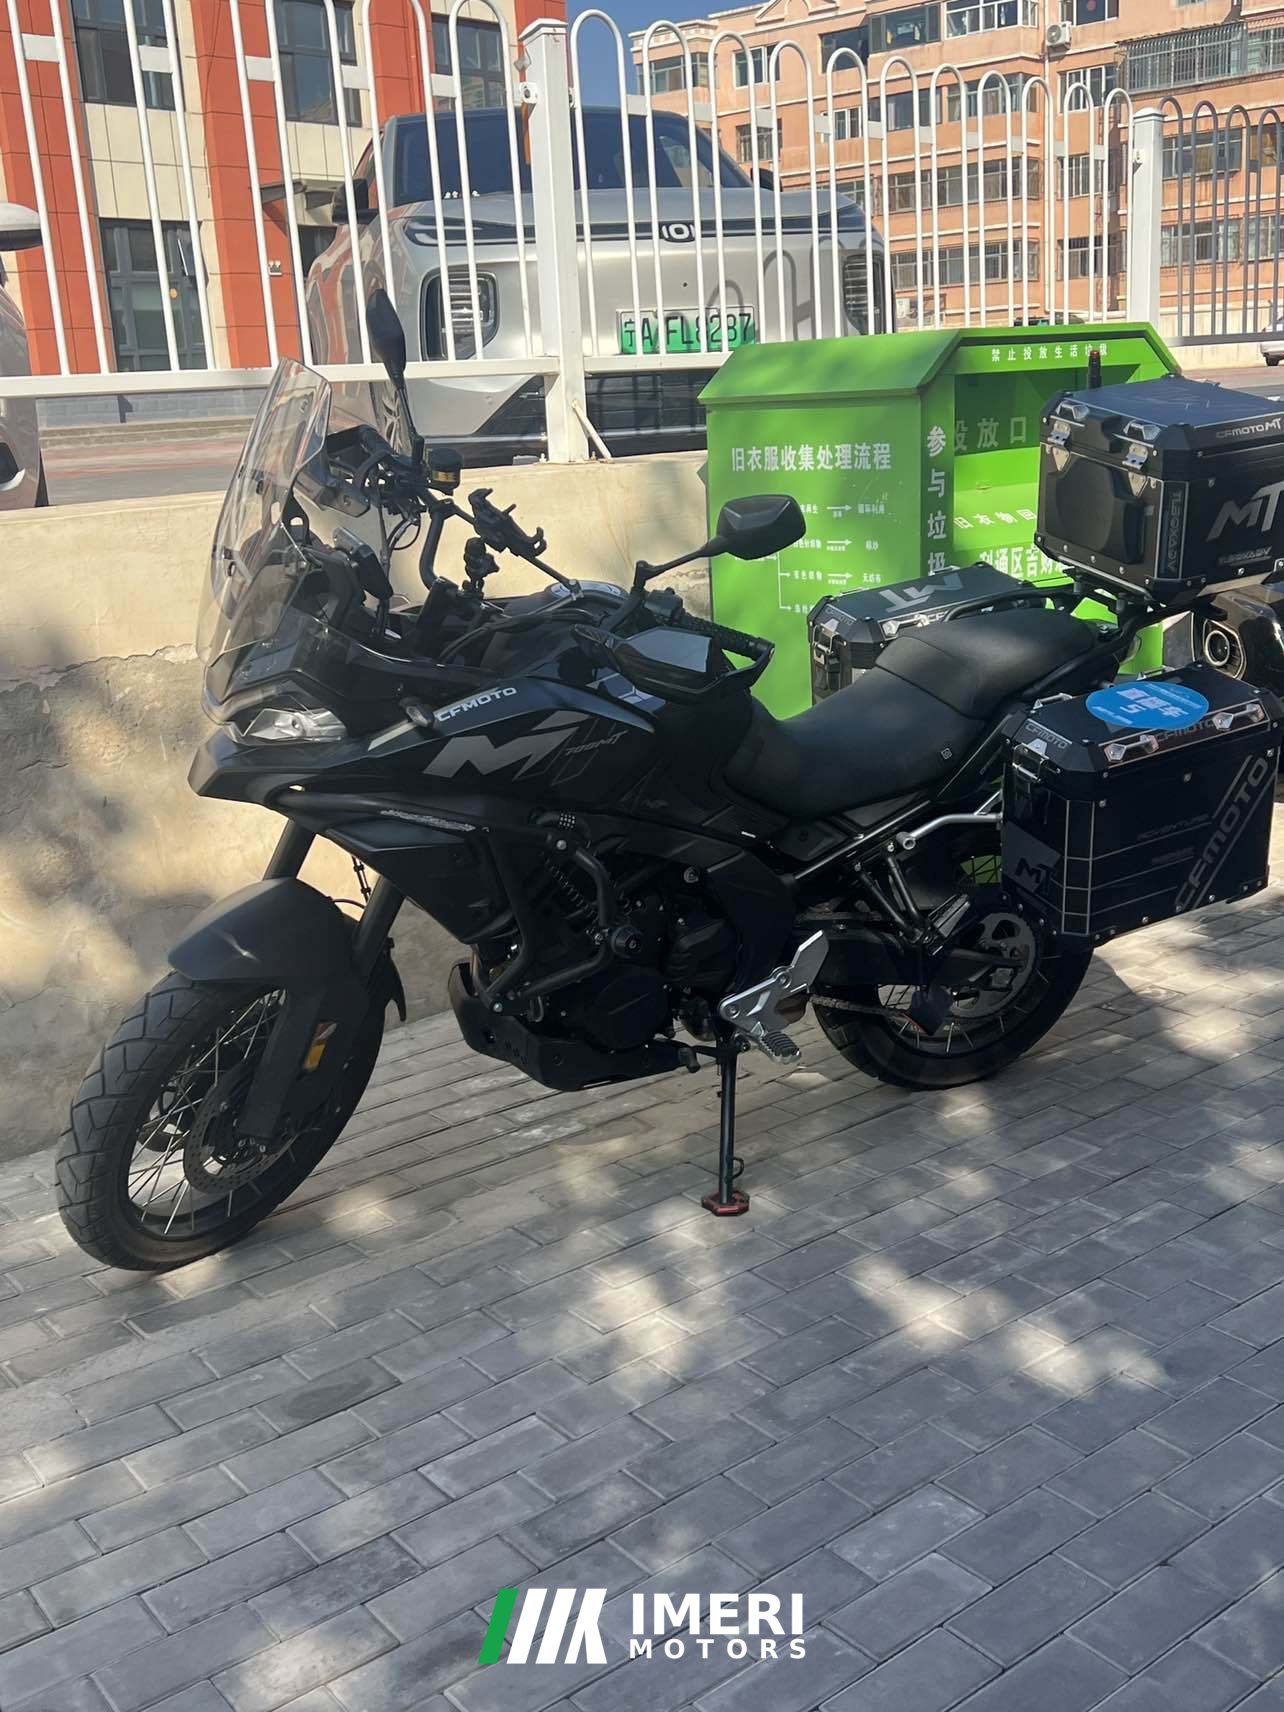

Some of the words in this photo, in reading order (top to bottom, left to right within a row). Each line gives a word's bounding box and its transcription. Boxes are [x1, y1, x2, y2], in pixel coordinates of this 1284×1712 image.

[731, 442, 892, 472] 旧衣服收集处理流程
[436, 687, 517, 722] CFMOTO
[1025, 723, 1069, 749] CFMOTO
[1175, 757, 1269, 911] CFMOTO
